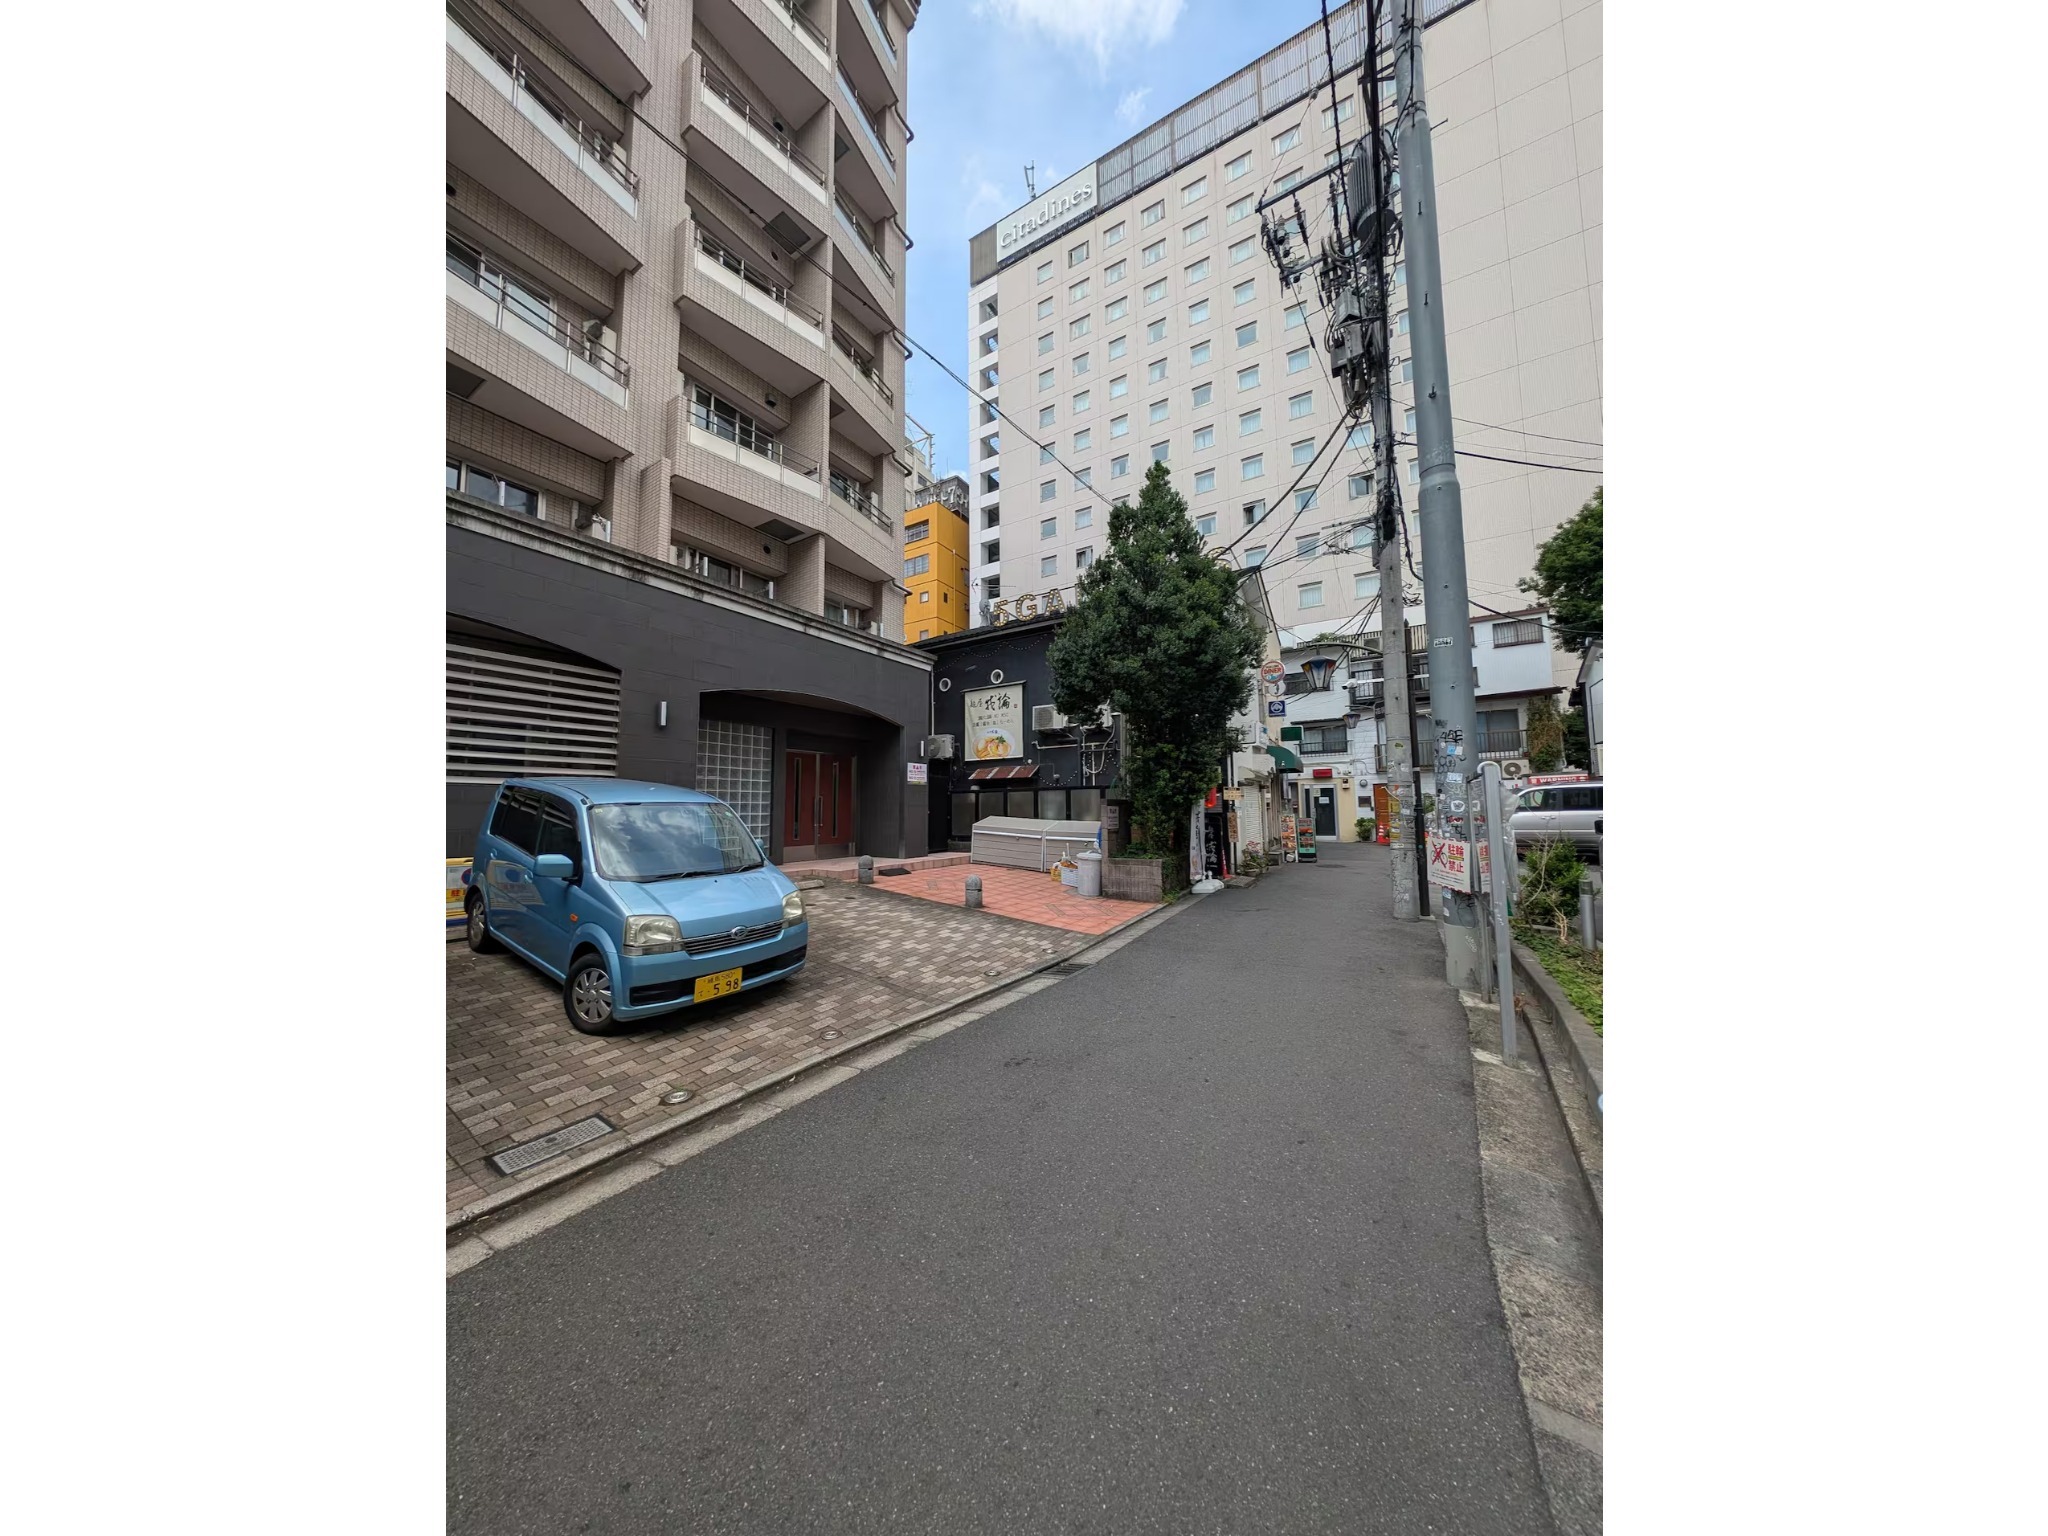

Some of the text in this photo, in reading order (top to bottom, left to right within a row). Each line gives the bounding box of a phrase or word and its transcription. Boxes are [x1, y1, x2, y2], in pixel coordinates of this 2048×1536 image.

[1000, 181, 1092, 248] citadines
[993, 583, 1081, 628] 5GA
[1448, 860, 1465, 873] 禁止
